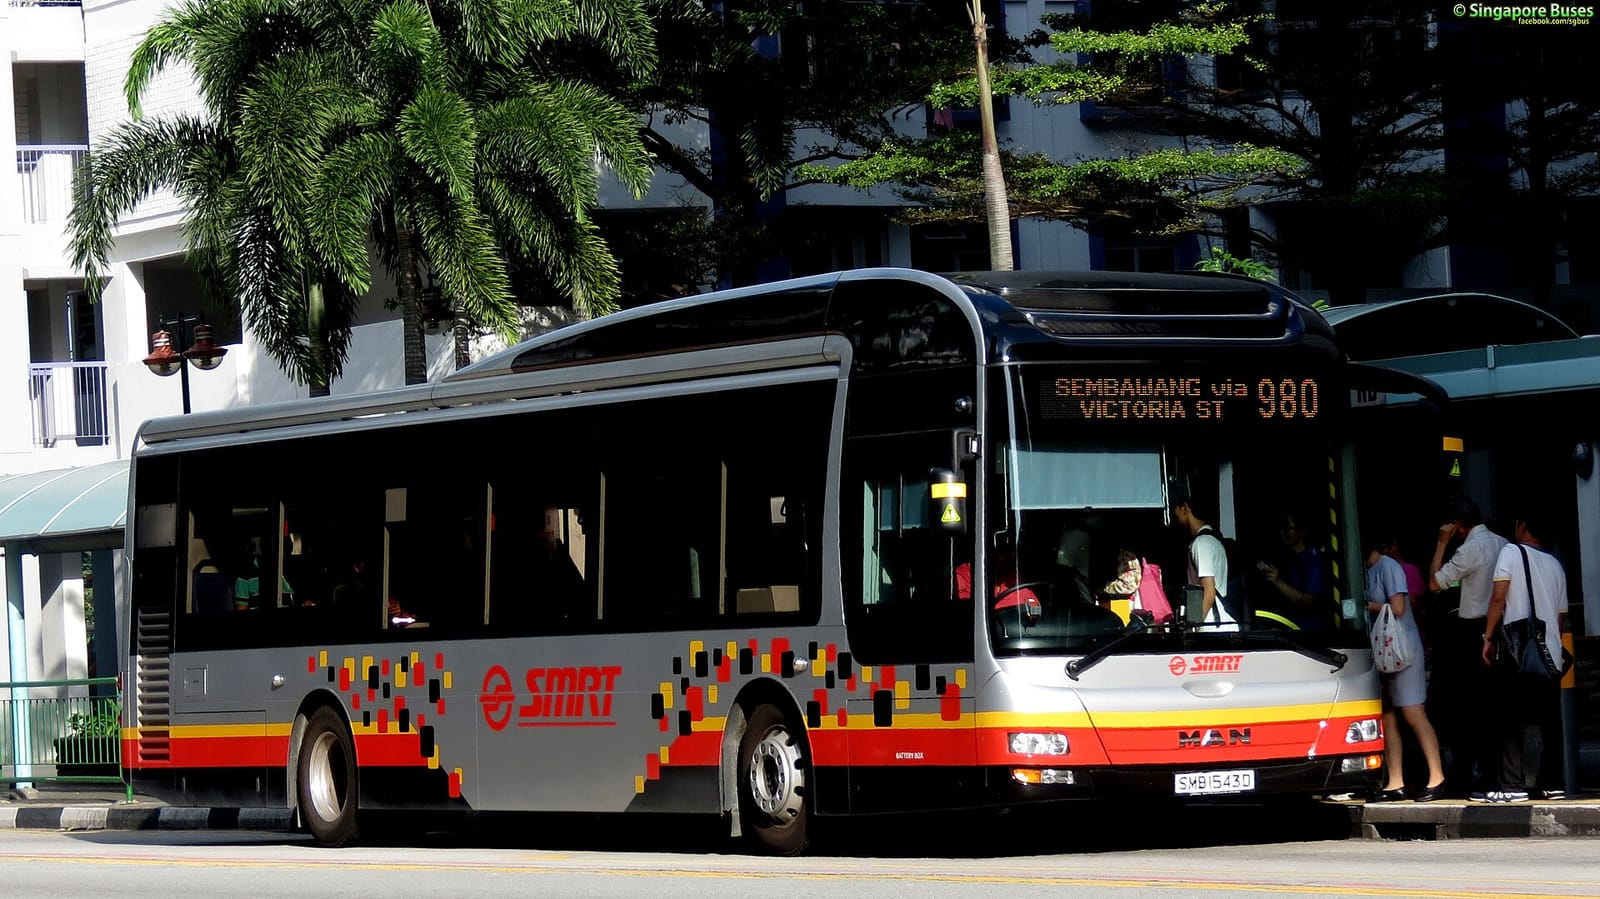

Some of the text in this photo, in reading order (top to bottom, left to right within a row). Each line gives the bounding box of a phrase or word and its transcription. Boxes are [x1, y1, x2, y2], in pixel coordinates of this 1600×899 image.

[1055, 378, 1319, 418] SEMBAWANG via 980
[1080, 400, 1225, 419] VICTORIA ST
[1190, 654, 1244, 672] SMRT
[518, 665, 623, 718] SMRT
[1178, 727, 1251, 748] MAN
